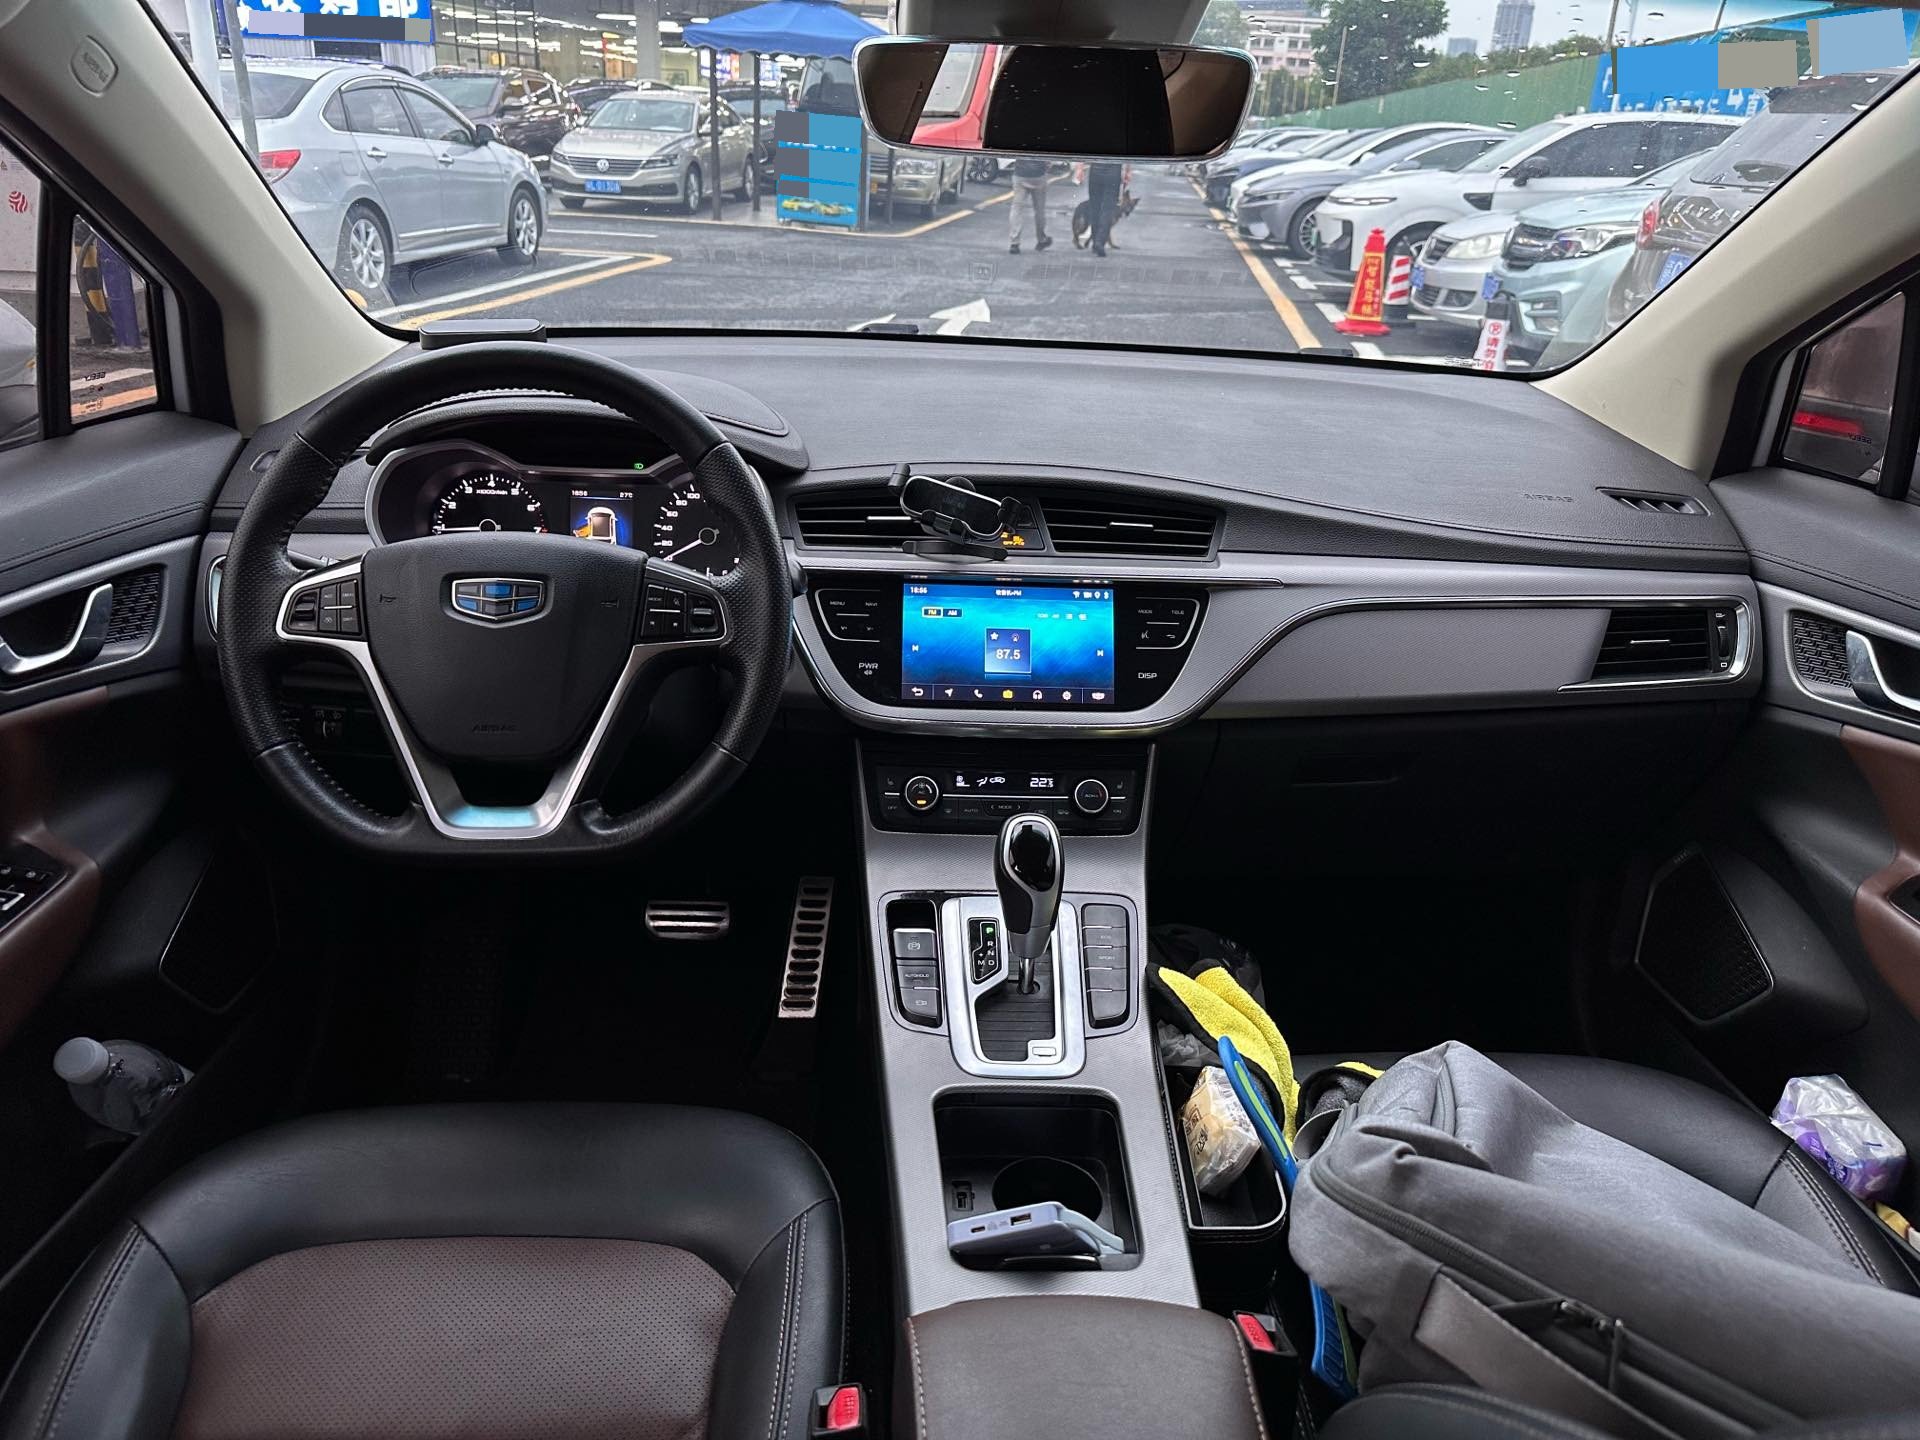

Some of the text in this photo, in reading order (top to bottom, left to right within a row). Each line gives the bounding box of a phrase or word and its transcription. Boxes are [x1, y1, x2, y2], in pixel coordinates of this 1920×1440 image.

[995, 650, 1021, 660] 87.5
[858, 662, 879, 670] PWR
[1137, 672, 1158, 680] DISP
